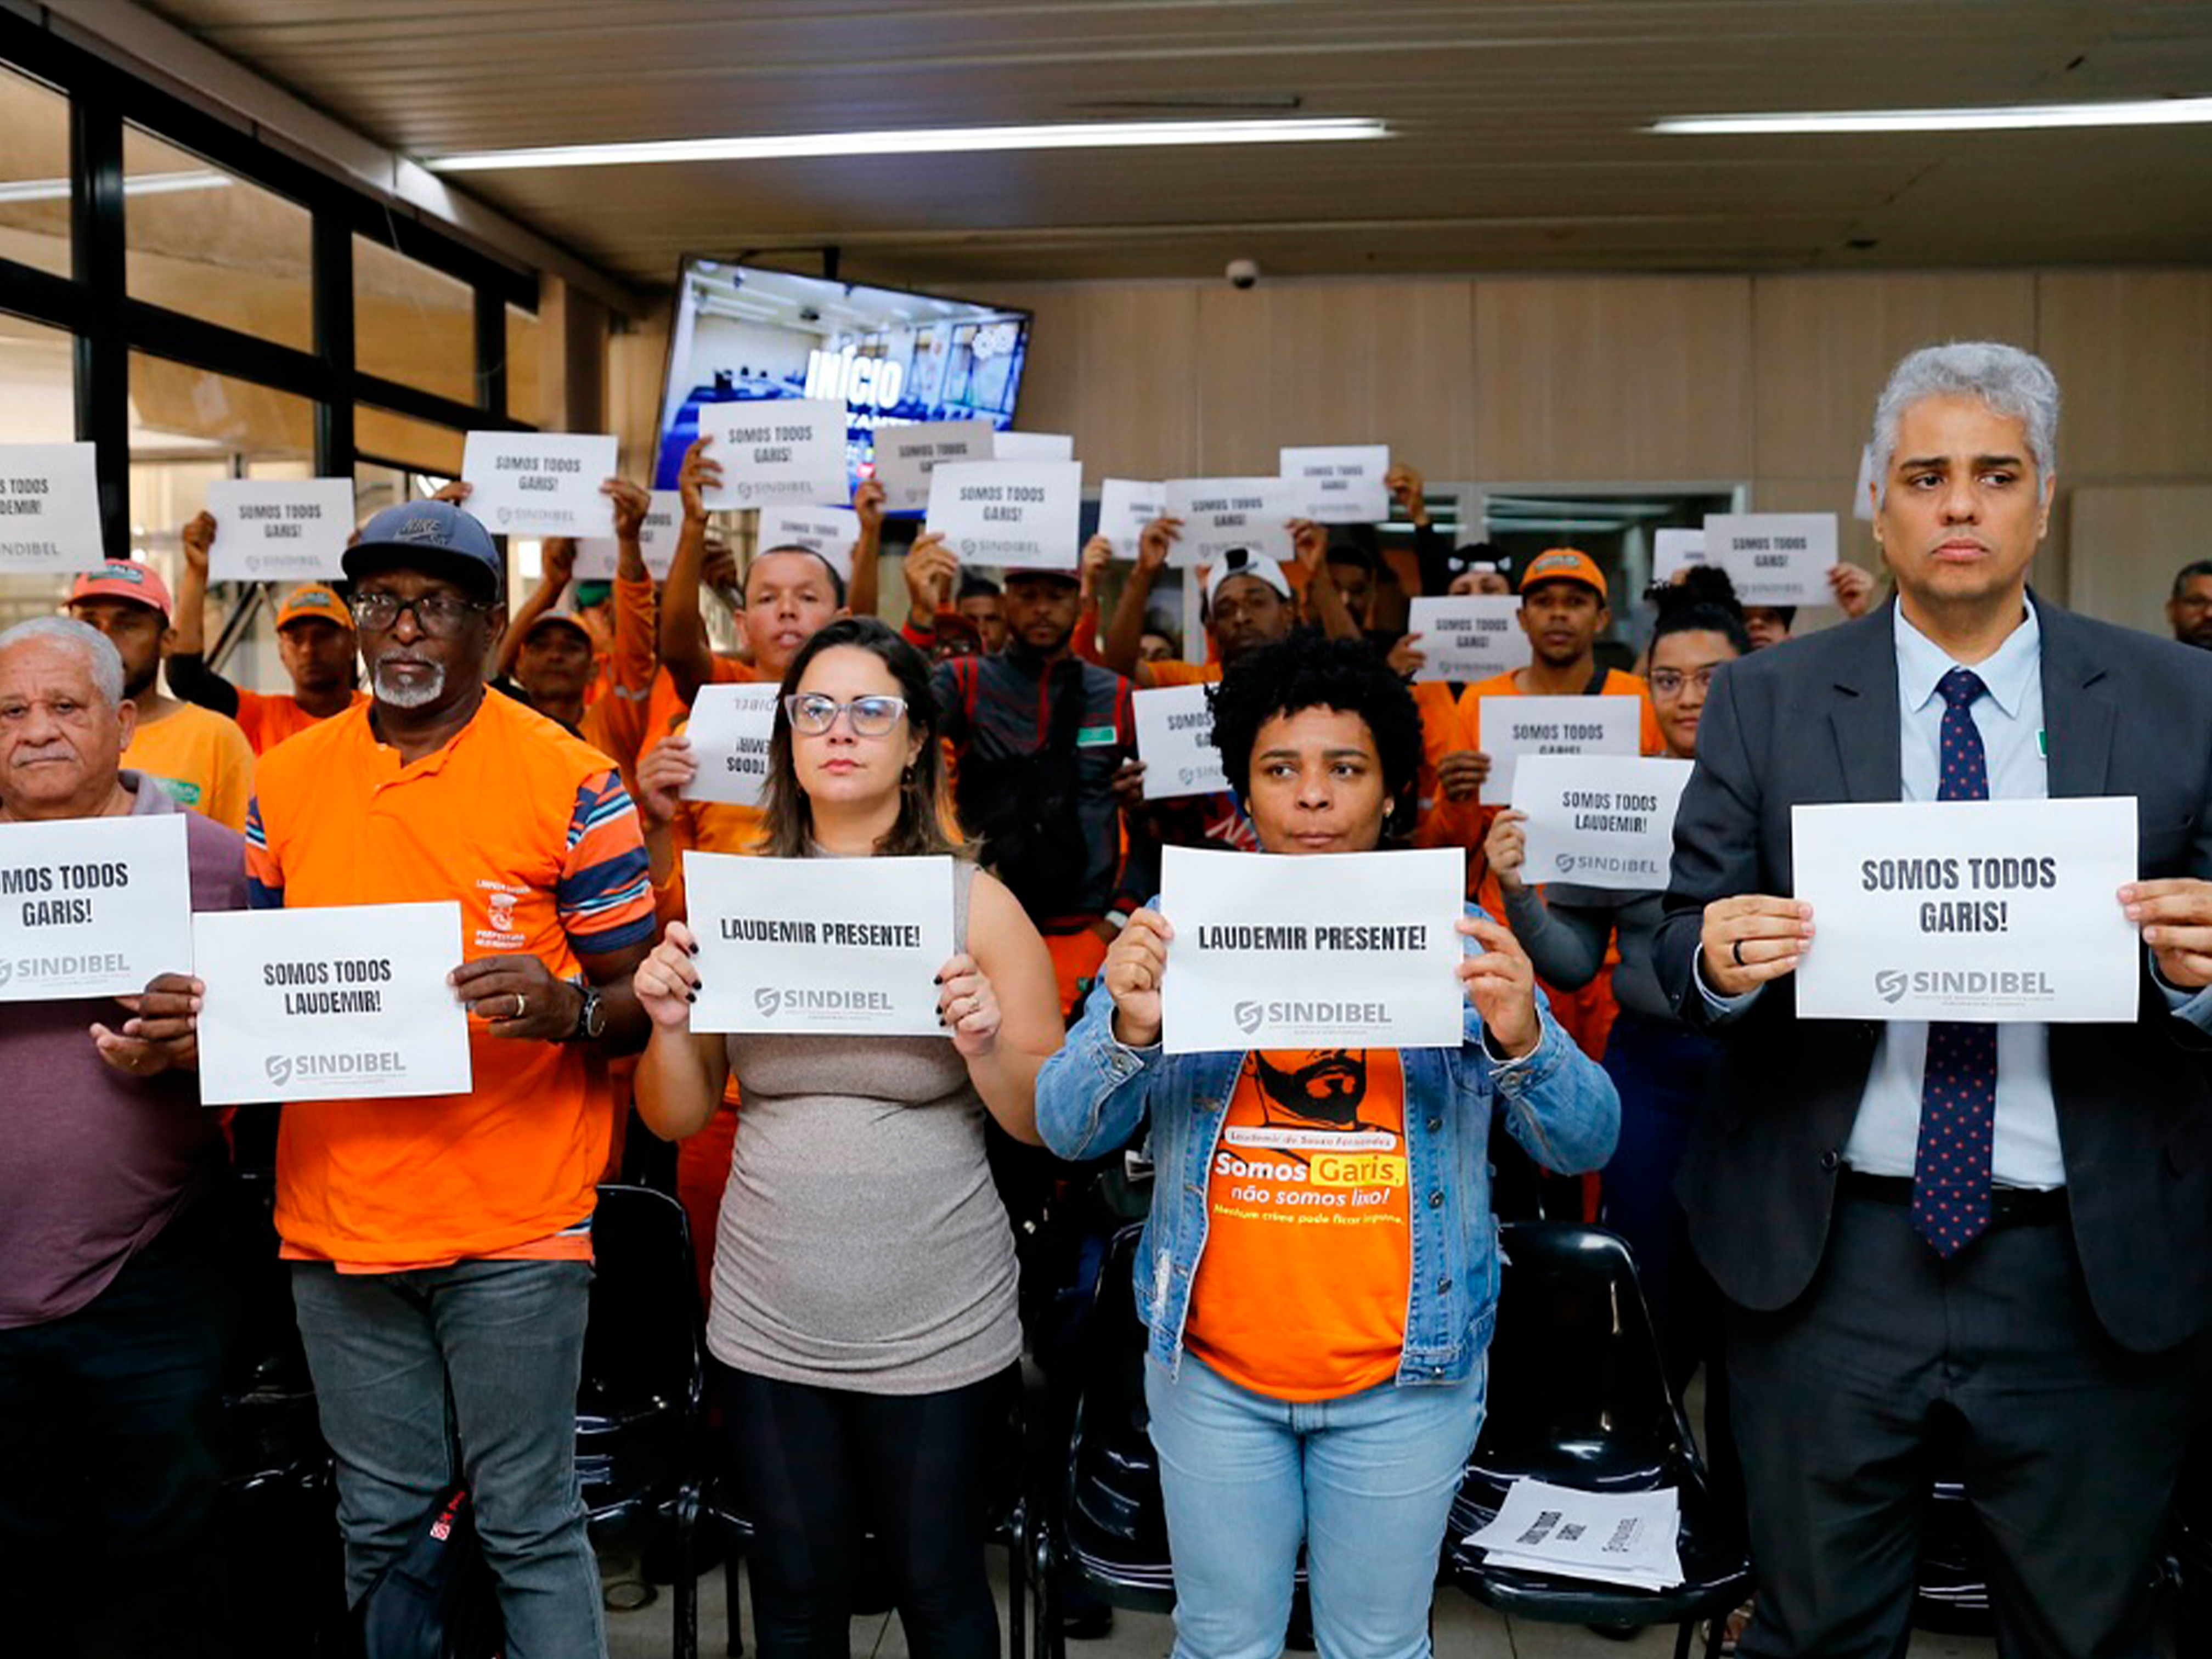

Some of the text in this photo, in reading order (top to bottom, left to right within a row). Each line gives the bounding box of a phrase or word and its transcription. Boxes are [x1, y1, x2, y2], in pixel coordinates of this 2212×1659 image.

[804, 345, 902, 409] INÍCIO
[729, 425, 812, 443] SOMOS TODOS
[495, 456, 581, 473] SOMOS TODOS
[754, 447, 792, 463] GARIS!
[10, 478, 49, 494] TODOS
[518, 476, 558, 492] GARIS!
[960, 486, 1045, 502] SOMOS TODOS
[0, 500, 42, 515] DEMIR!
[239, 504, 321, 520] SOMOS TODOS
[983, 506, 1023, 521] GARIS!
[1191, 497, 1263, 512] SOMOS TODOS
[264, 523, 302, 538] GARIS!
[0, 542, 61, 556] NDIBEL
[1732, 537, 1807, 550] SOMOS TODOS
[1436, 618, 1508, 631] SOMOS TODOS
[734, 697, 775, 712] DIBEL
[1167, 713, 1212, 731] SOMOS
[1512, 724, 1604, 740] SOMOS TODOS
[726, 756, 765, 775] TODOS
[1562, 791, 1658, 811] SOMOS TODOS
[1575, 814, 1647, 833] LAUDEMIR!
[1577, 855, 1658, 873] SINDIBEL
[0, 862, 129, 894] MOS TODOS
[1861, 857, 2056, 891] SOMOS TODOS
[22, 898, 93, 927] GARIS!
[1920, 901, 2007, 933] GARIS!
[721, 919, 921, 947] LAUDEMIR PRESENTE!
[1199, 926, 1426, 950] LAUDEMIR PRESENTE!
[16, 953, 131, 977] SINDIBEL
[264, 959, 392, 986] SOMOS TODOS
[1913, 972, 2055, 994] SINDIBEL
[285, 990, 382, 1015] LAUDEMIR!
[785, 989, 894, 1011] SINDIBEL
[1268, 1002, 1392, 1023] SINDIBEL
[296, 1052, 406, 1075] SINDIBEL
[1215, 1153, 1400, 1186] Somos Garis,
[1232, 1186, 1390, 1207] não somos lixo!
